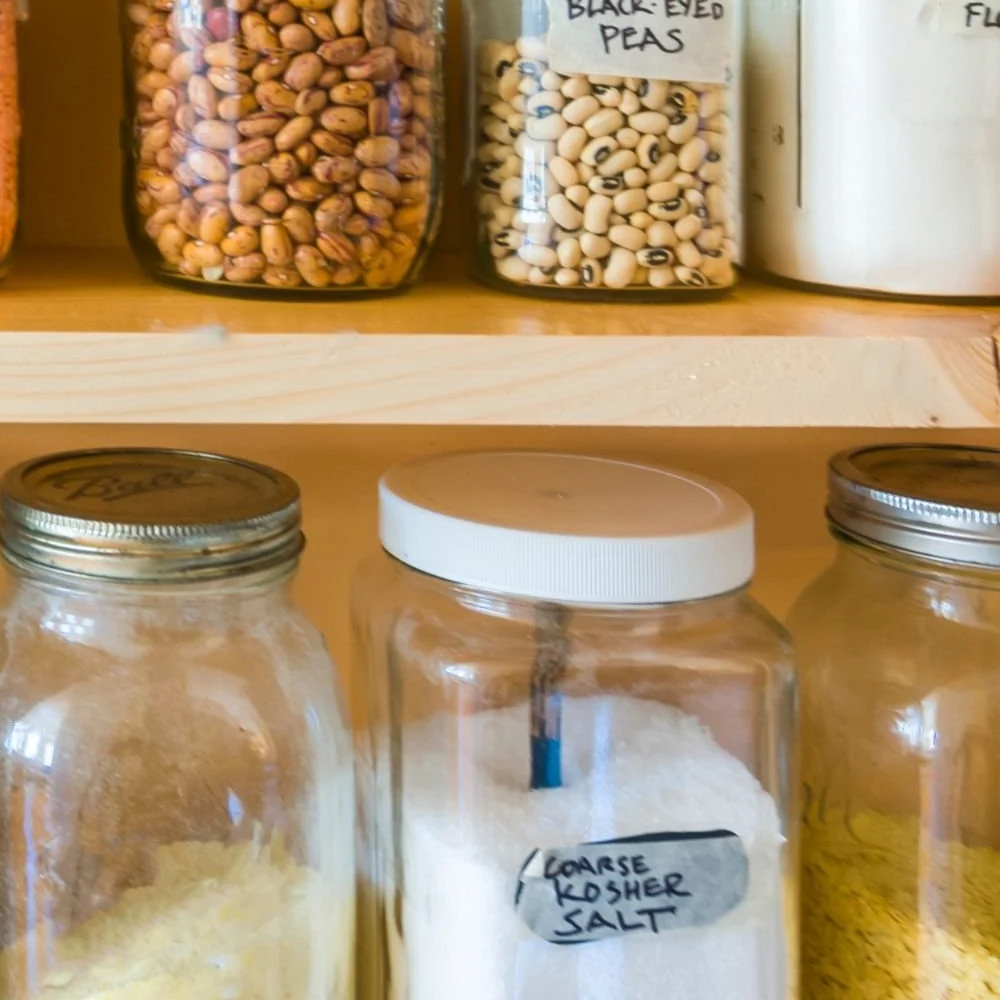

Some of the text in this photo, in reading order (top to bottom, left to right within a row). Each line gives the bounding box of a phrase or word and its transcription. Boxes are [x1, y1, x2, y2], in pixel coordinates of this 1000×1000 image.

[599, 23, 685, 54] PEAS
[543, 855, 650, 880] COARSE
[553, 872, 693, 907] KOSHER
[554, 906, 678, 936] SALT
